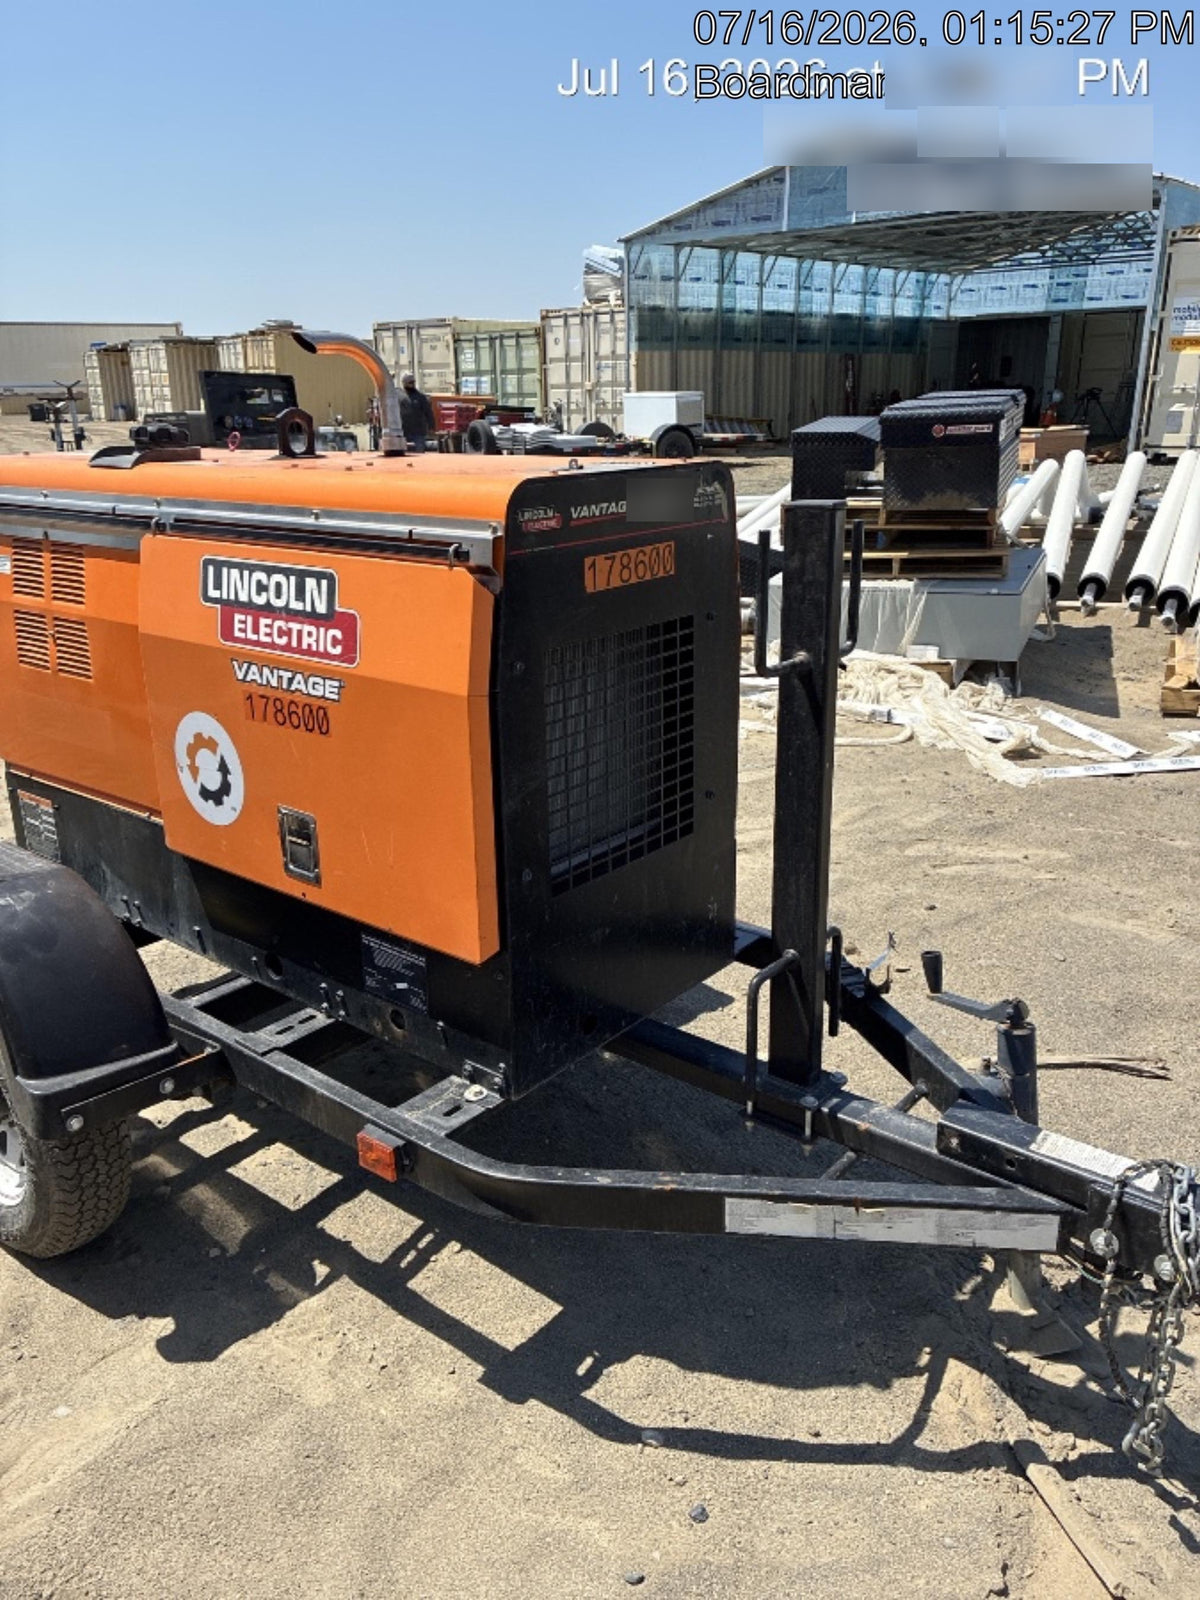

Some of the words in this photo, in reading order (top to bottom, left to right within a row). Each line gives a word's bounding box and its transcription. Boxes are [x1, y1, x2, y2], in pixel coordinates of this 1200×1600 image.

[569, 500, 627, 519] VANTAG
[587, 543, 673, 591] 178600
[207, 565, 328, 614] LINCOLN
[233, 612, 343, 655] ELECTRIC
[231, 659, 342, 702] VANTAGE
[246, 693, 330, 735] 178600
